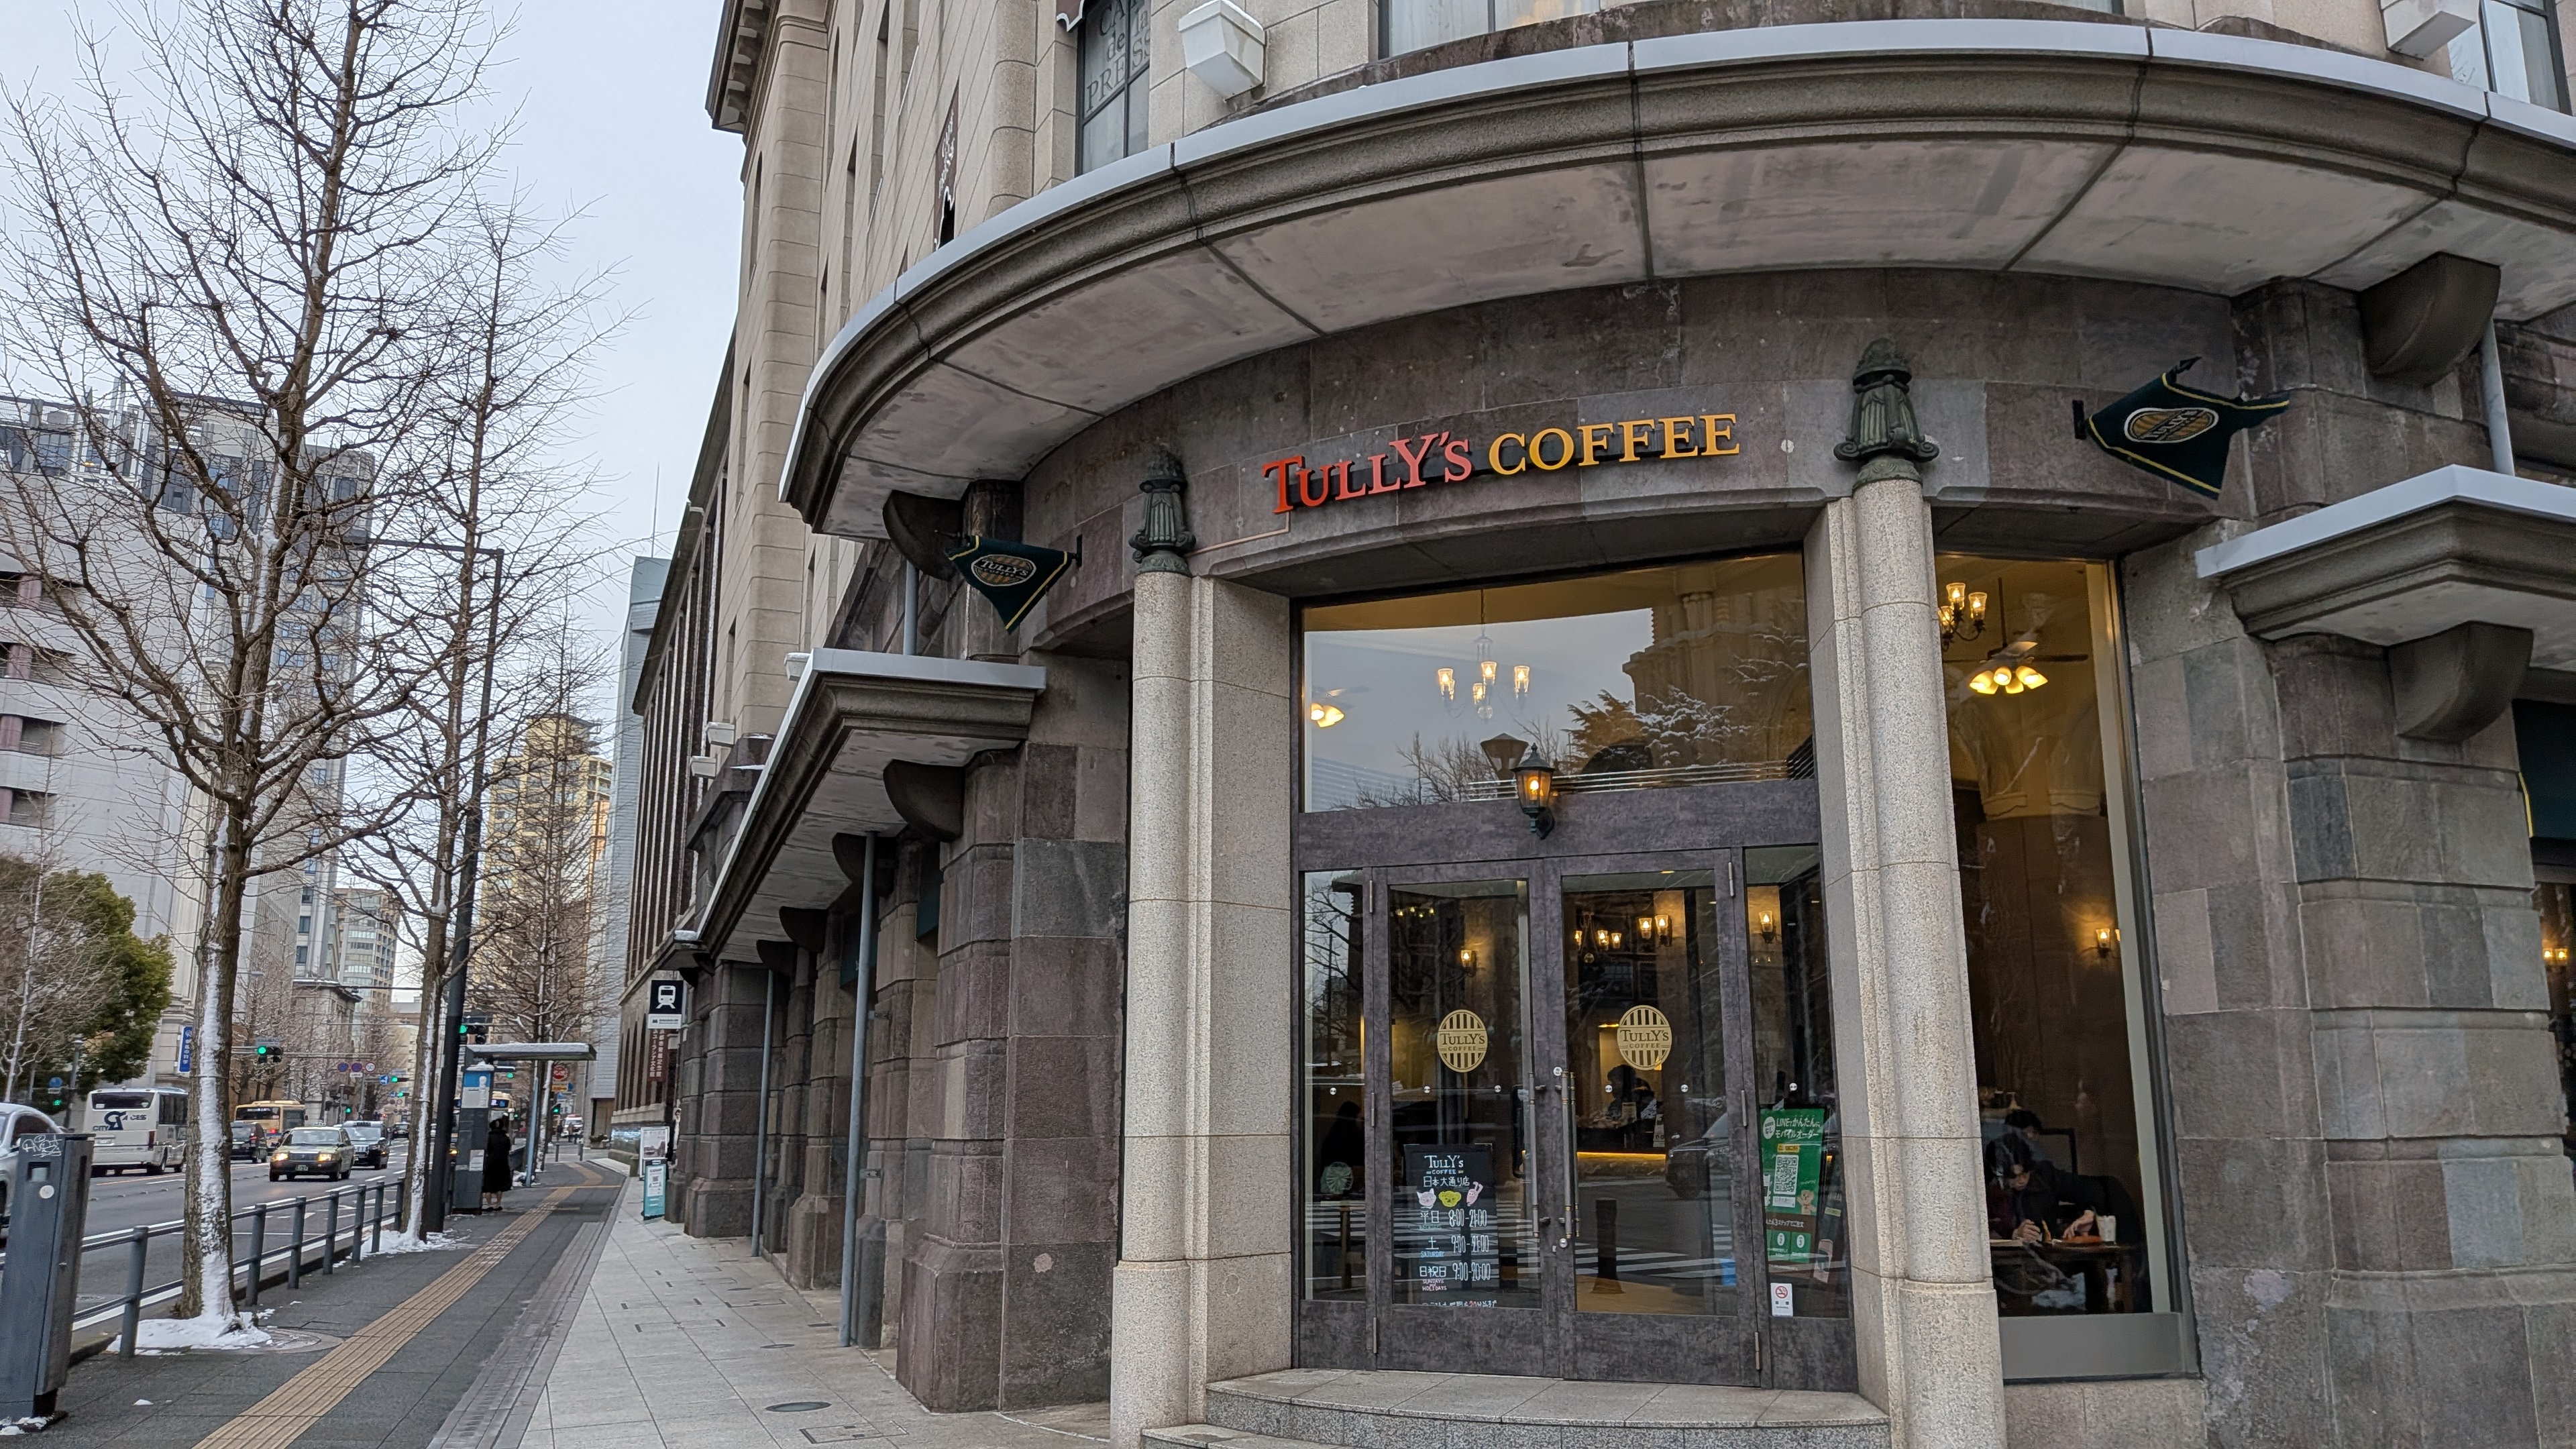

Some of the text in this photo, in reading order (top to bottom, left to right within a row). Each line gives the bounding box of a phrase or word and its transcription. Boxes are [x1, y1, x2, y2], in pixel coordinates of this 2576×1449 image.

[1107, 8, 1148, 62] de la
[1262, 413, 1740, 514] TULLY'S COFFEE
[980, 559, 1028, 576] TULLY'S
[1440, 1033, 1485, 1046] TULLY'S
[1620, 1030, 1670, 1042] TULLY'S
[1775, 1129, 1819, 1139] モバイルオーダー
[1423, 1176, 1470, 1187] 日本大通り店
[1420, 1210, 1440, 1224] 平日
[1426, 1236, 1439, 1250] 土
[1419, 1266, 1447, 1277] 日祝日
